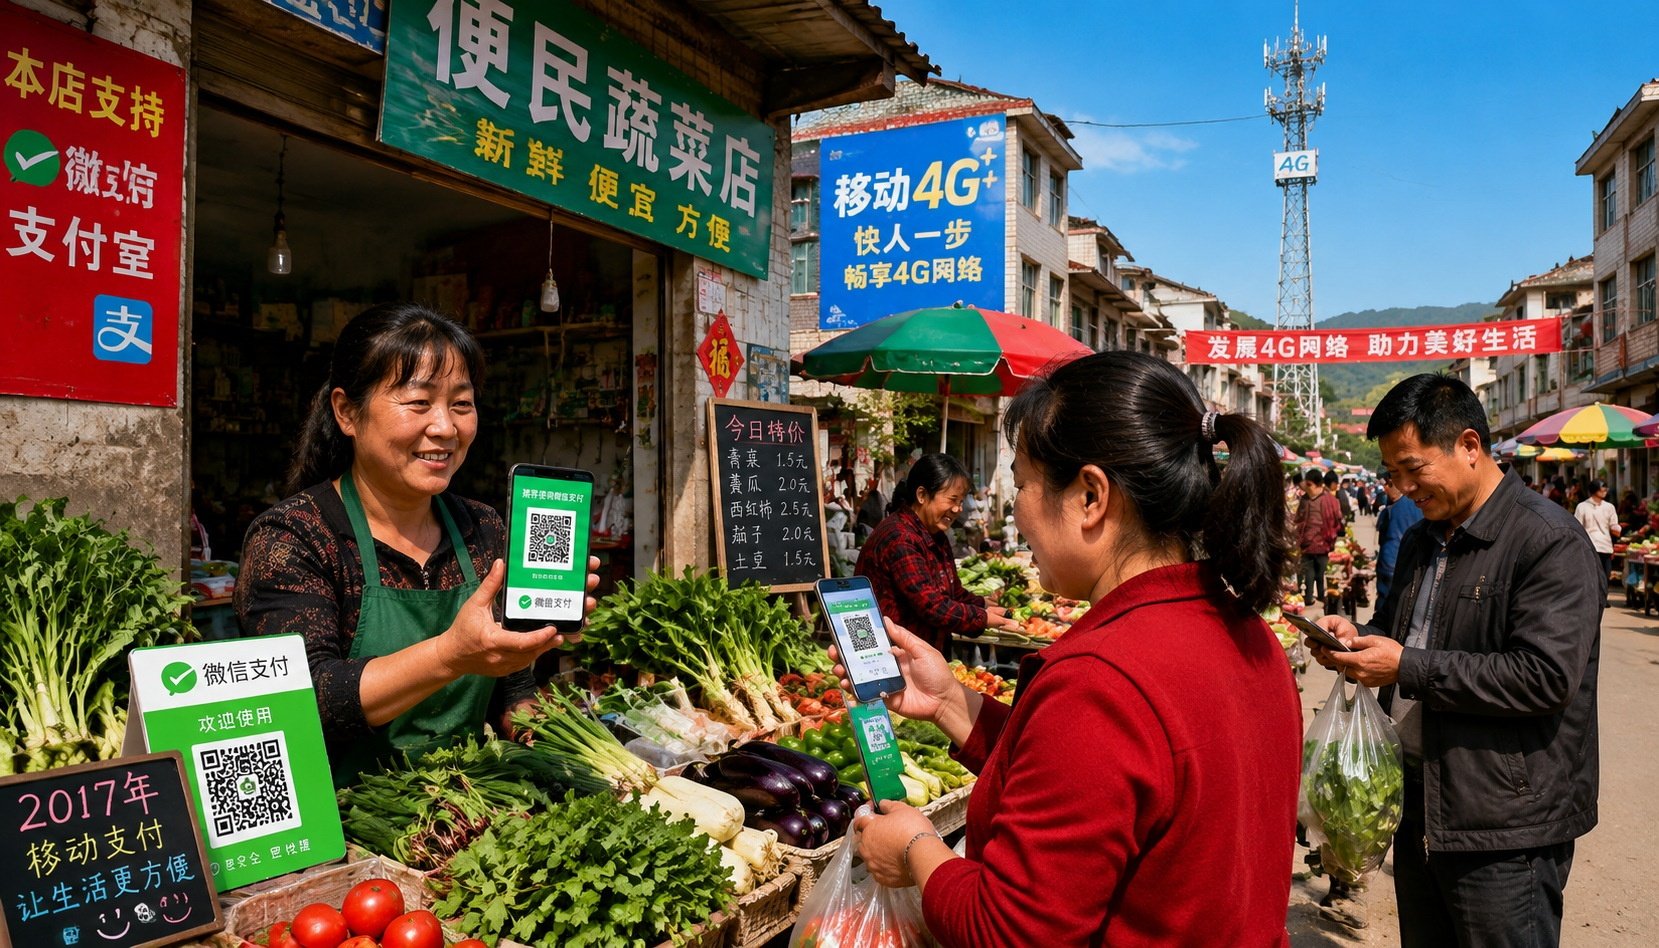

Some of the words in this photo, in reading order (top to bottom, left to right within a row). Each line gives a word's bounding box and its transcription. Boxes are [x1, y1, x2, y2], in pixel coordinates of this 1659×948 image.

[4, 47, 164, 138] 本店支持
[427, 0, 760, 218] 便民蔬菜店
[588, 163, 656, 223] 便宜
[675, 203, 732, 253] 方便
[854, 218, 972, 256] 快人一步
[844, 255, 983, 291] 畅享4G网络
[709, 338, 730, 379] 福
[1207, 334, 1349, 359] 发展4G网络
[1367, 325, 1537, 357] 助力美好生活
[725, 414, 806, 444] 今日特价
[777, 452, 808, 470] 1.5元
[778, 476, 811, 494] 2.0元
[780, 501, 813, 518] 2.5元
[782, 526, 815, 541] 2.0元
[784, 550, 816, 567] 1.5元
[202, 655, 289, 687] 微信支付
[18, 771, 159, 832] 2017年
[26, 818, 163, 879] 移动支付
[16, 853, 196, 922] 让生活更方便
